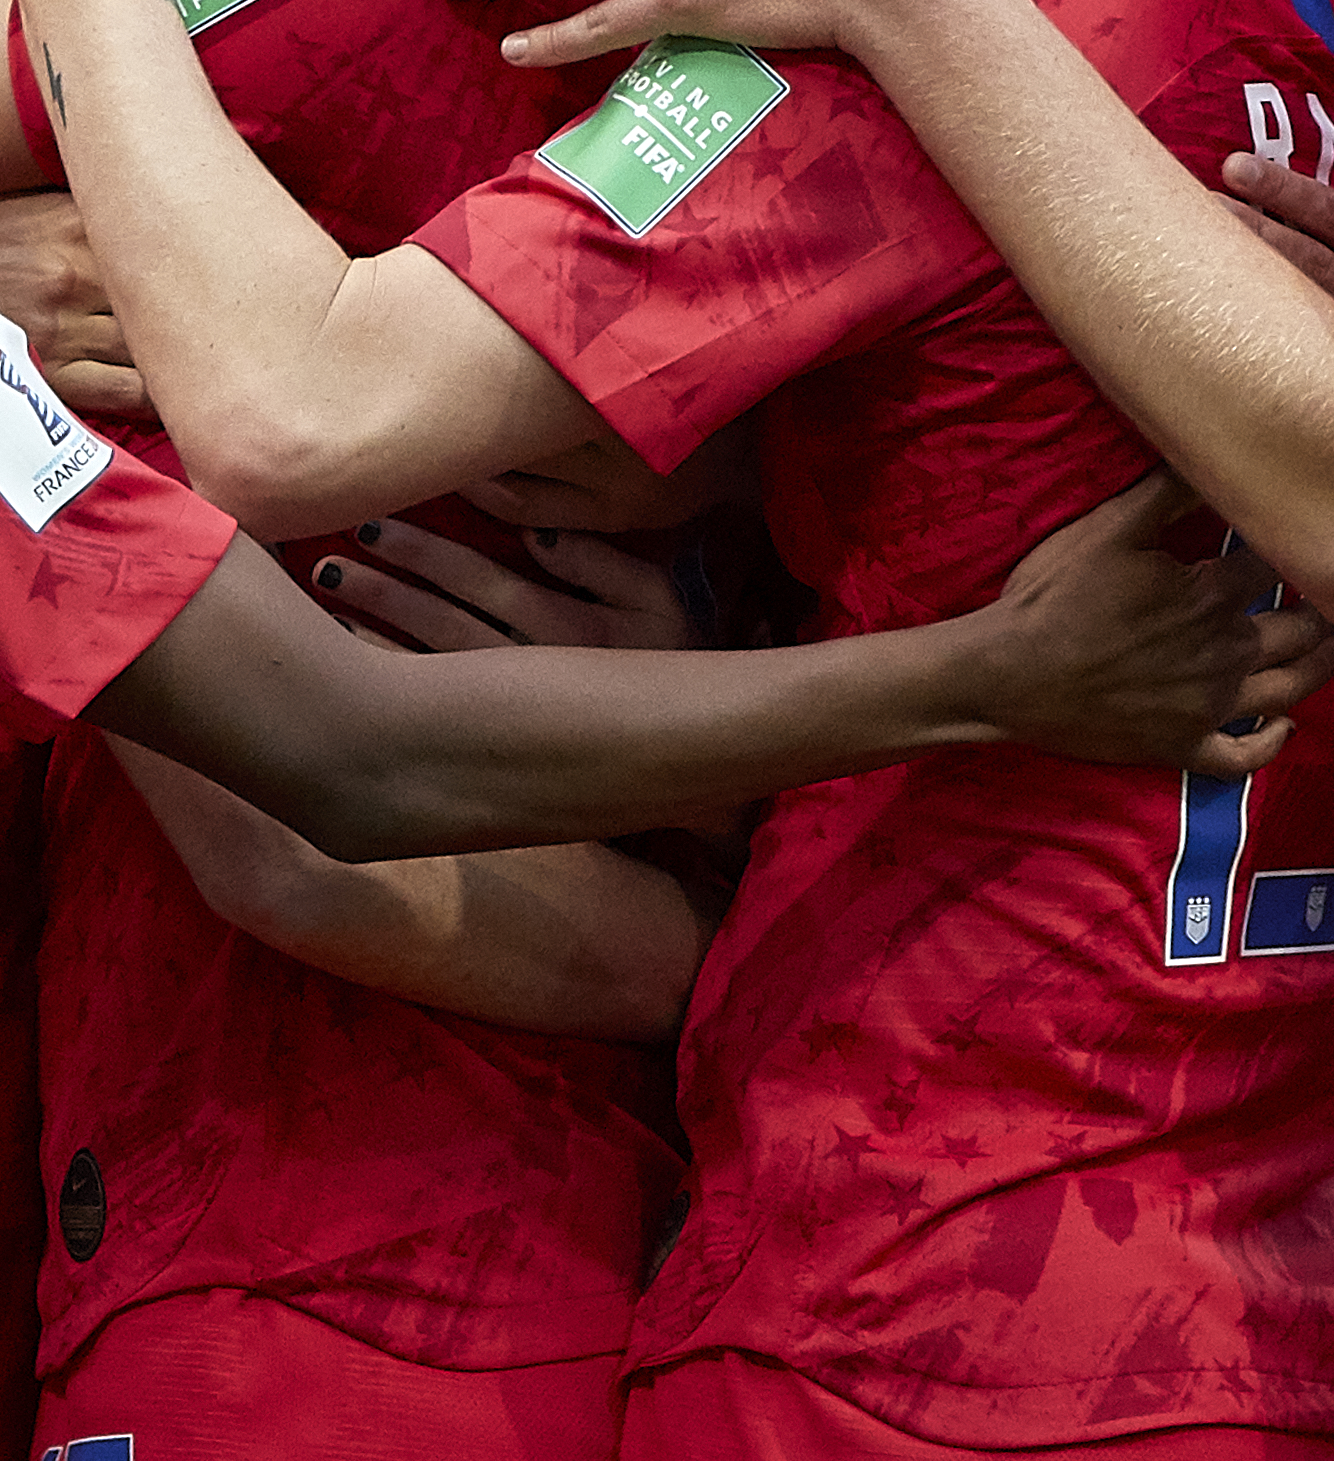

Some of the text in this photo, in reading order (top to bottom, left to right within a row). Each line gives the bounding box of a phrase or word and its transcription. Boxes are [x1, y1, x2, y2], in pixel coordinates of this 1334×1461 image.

[619, 69, 714, 150] FOOTBALL
[641, 54, 734, 133] IVING
[620, 124, 680, 185] FIFA
[33, 441, 95, 503] FRANCE
